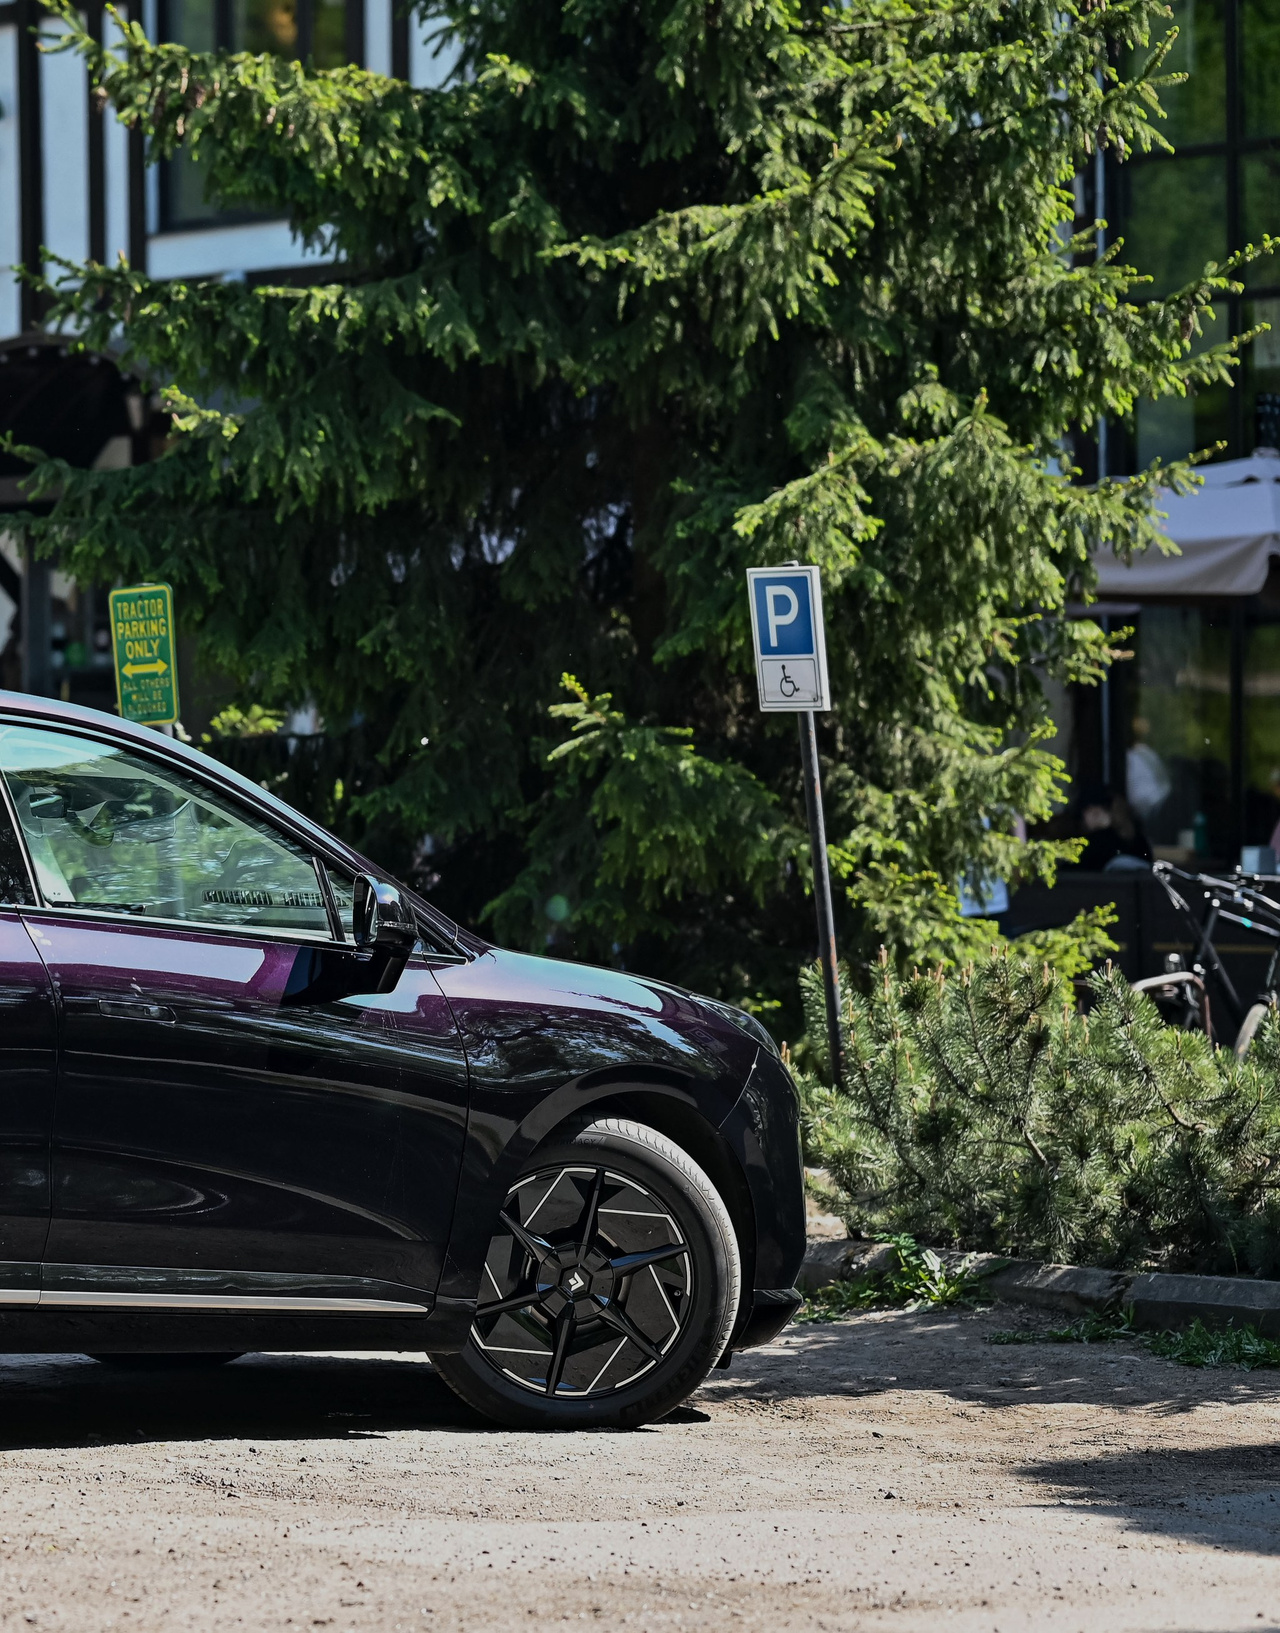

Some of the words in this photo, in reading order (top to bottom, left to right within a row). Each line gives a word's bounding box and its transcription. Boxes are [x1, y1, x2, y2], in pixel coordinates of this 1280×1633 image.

[116, 598, 165, 620] TRACTOR
[765, 584, 799, 648] P
[116, 617, 167, 640] PARKING
[125, 638, 160, 659] ONLY
